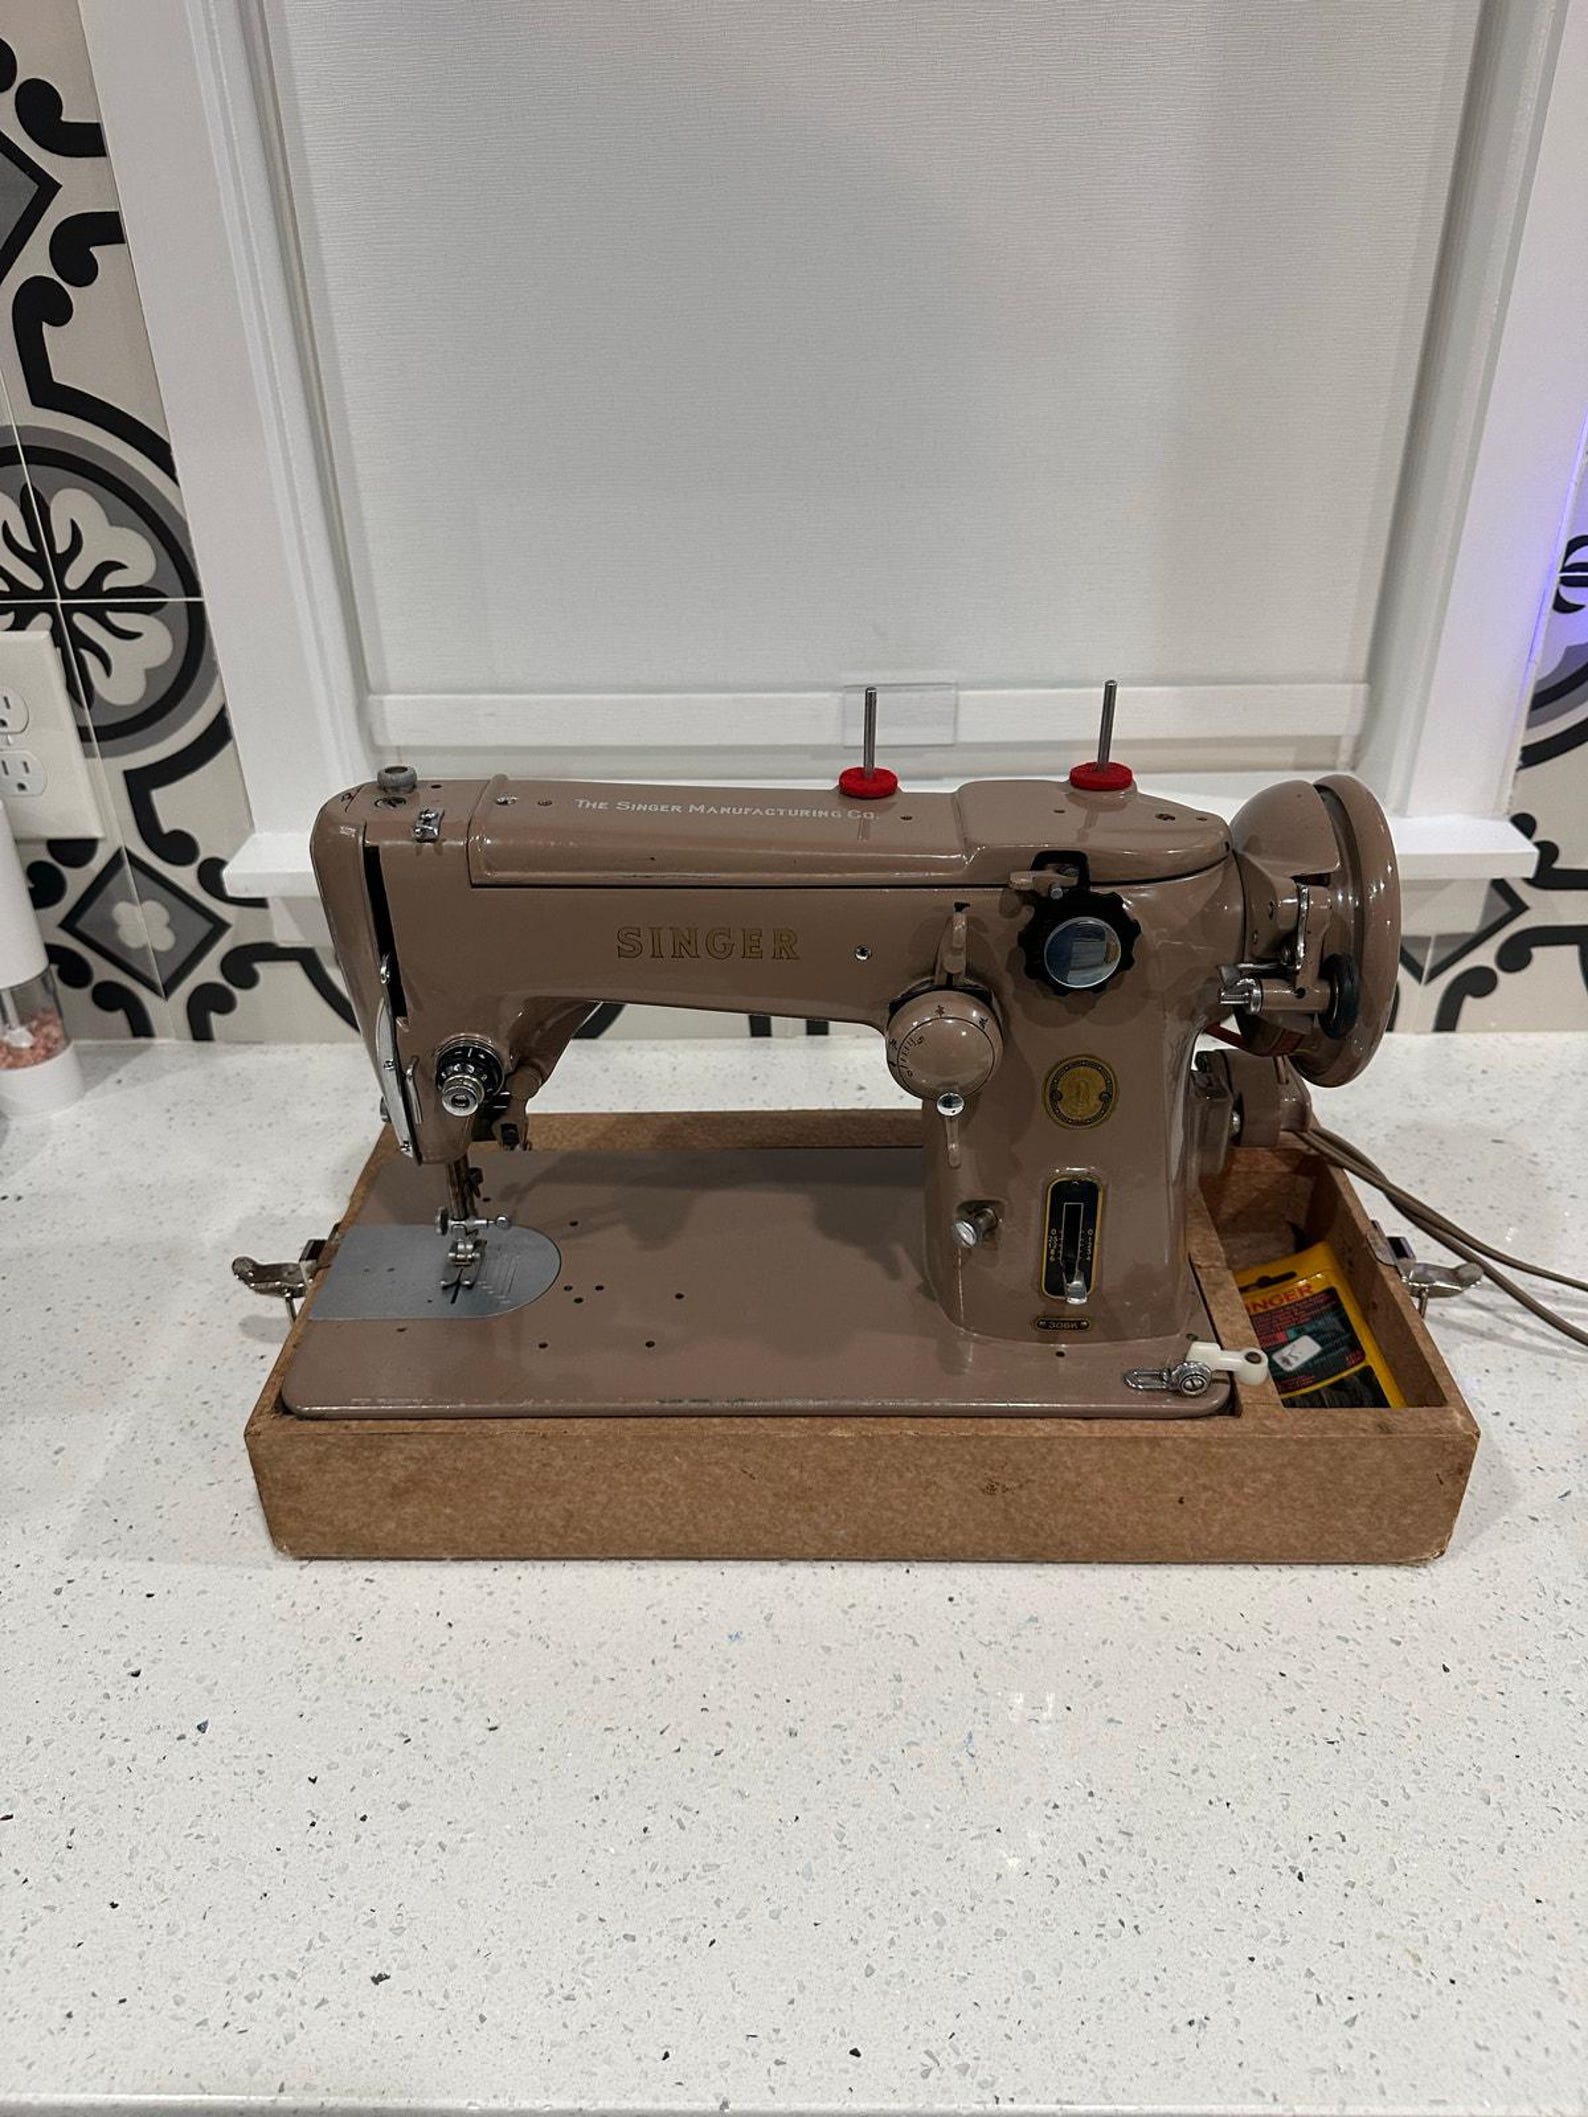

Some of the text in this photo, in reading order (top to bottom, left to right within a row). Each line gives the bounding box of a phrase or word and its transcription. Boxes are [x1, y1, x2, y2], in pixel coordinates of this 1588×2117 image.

[574, 799, 609, 810] THE
[616, 801, 683, 814] SINGER
[688, 804, 842, 818] MANUFACTURING
[617, 926, 801, 961] SINGER
[1244, 1284, 1313, 1313] INGER
